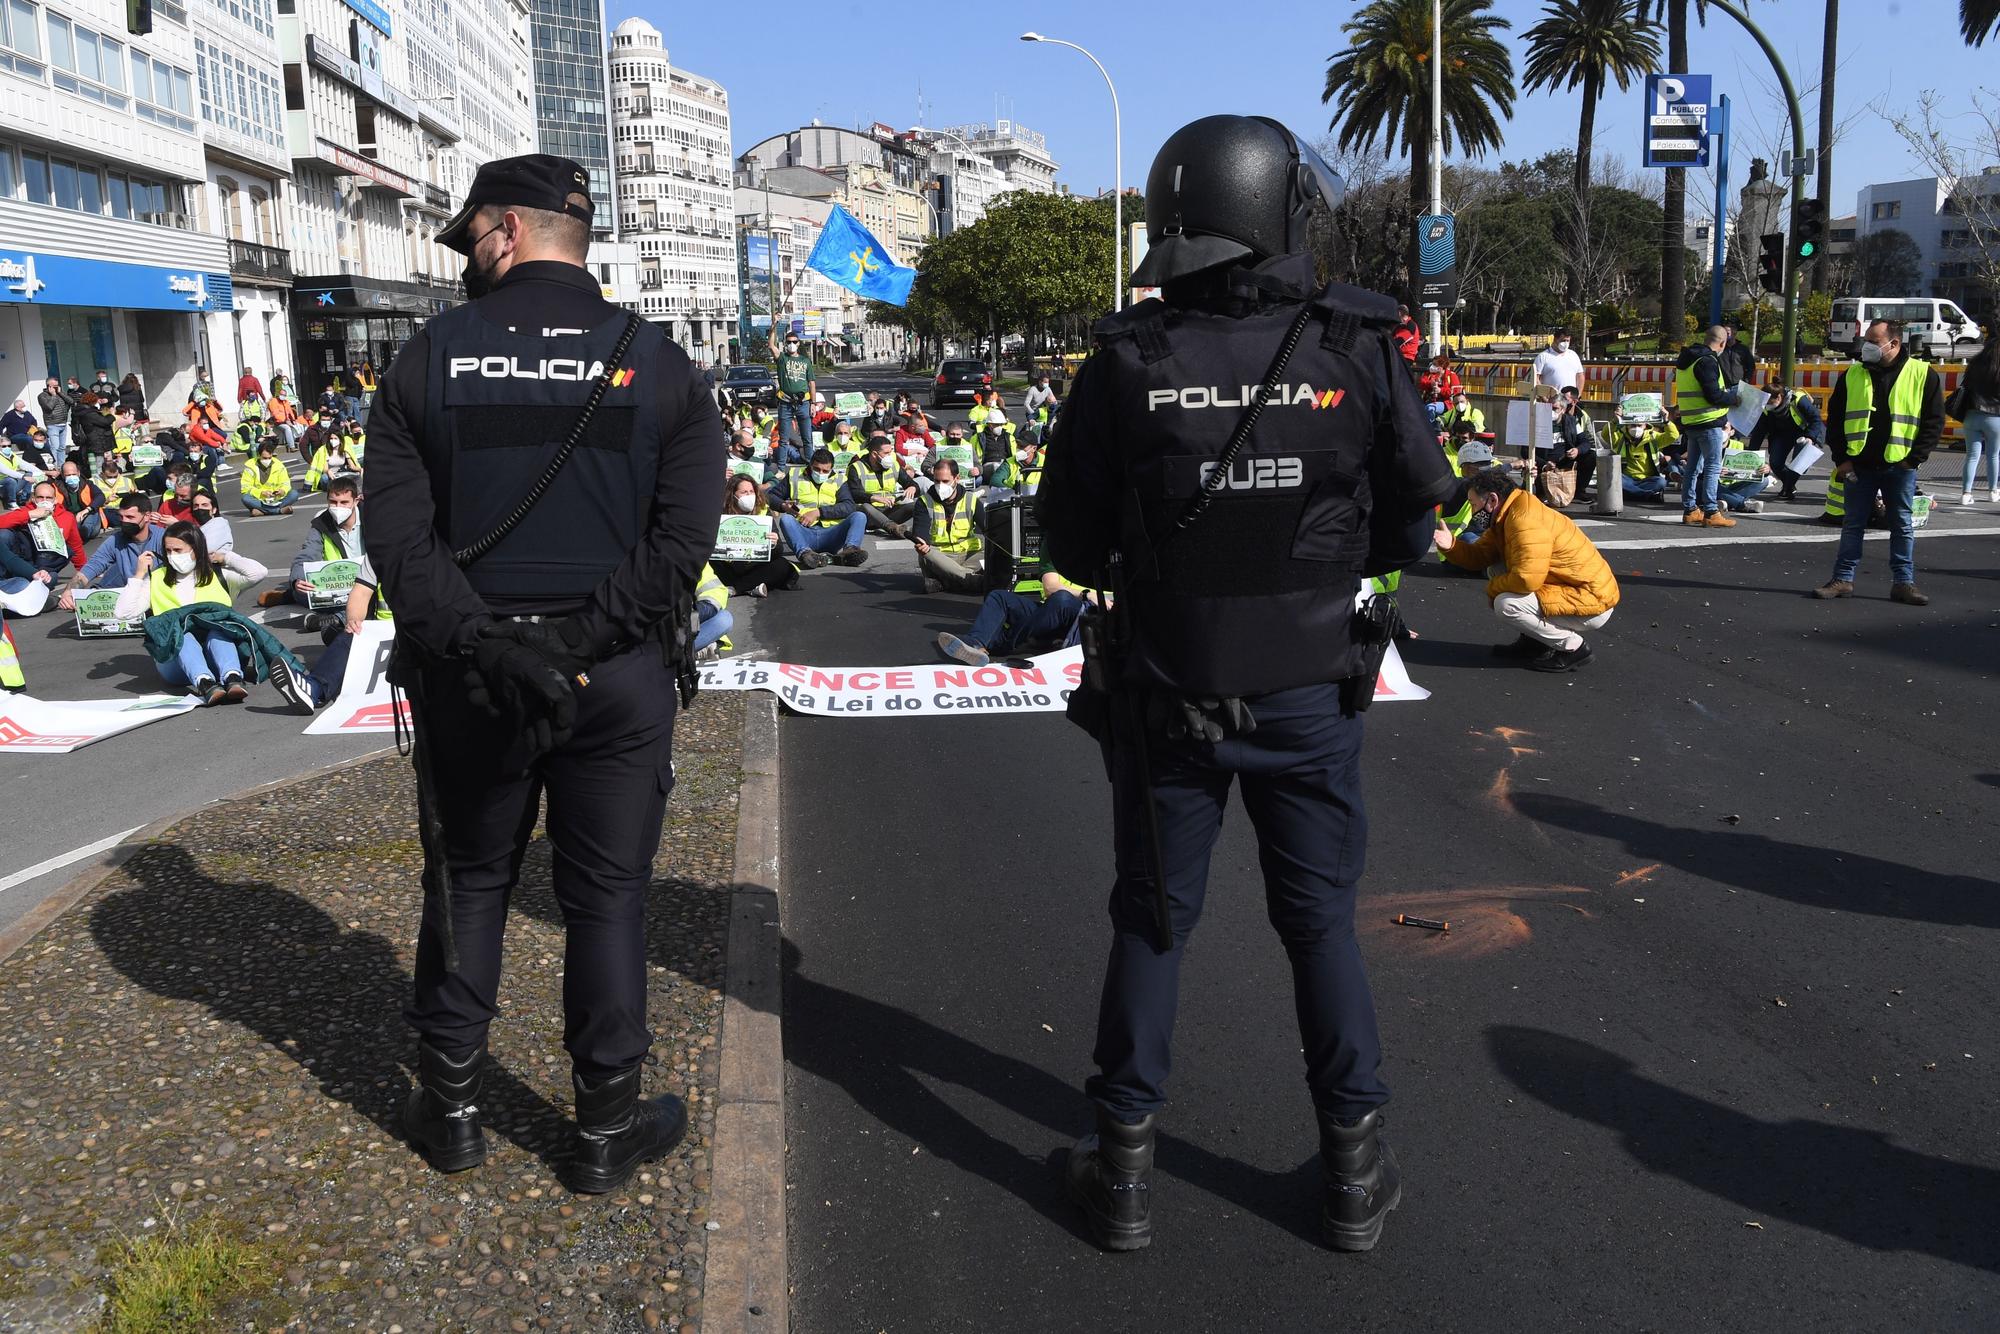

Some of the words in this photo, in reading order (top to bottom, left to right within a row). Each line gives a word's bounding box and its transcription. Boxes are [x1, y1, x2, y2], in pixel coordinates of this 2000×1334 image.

[1671, 105, 1705, 113] PÚBLICO
[943, 122, 988, 138] PASTOR
[450, 356, 607, 381] POLICIA
[1148, 382, 1320, 411] POLICIA
[337, 573, 357, 582] ENCE
[325, 582, 345, 590] PARO
[102, 603, 115, 611] ENC
[733, 670, 769, 685] 18
[778, 662, 916, 692] ENCE
[933, 666, 1048, 689] NON
[781, 684, 816, 709] da
[826, 695, 873, 712] Lei
[885, 692, 921, 711] do
[933, 690, 1051, 710] Cambio
